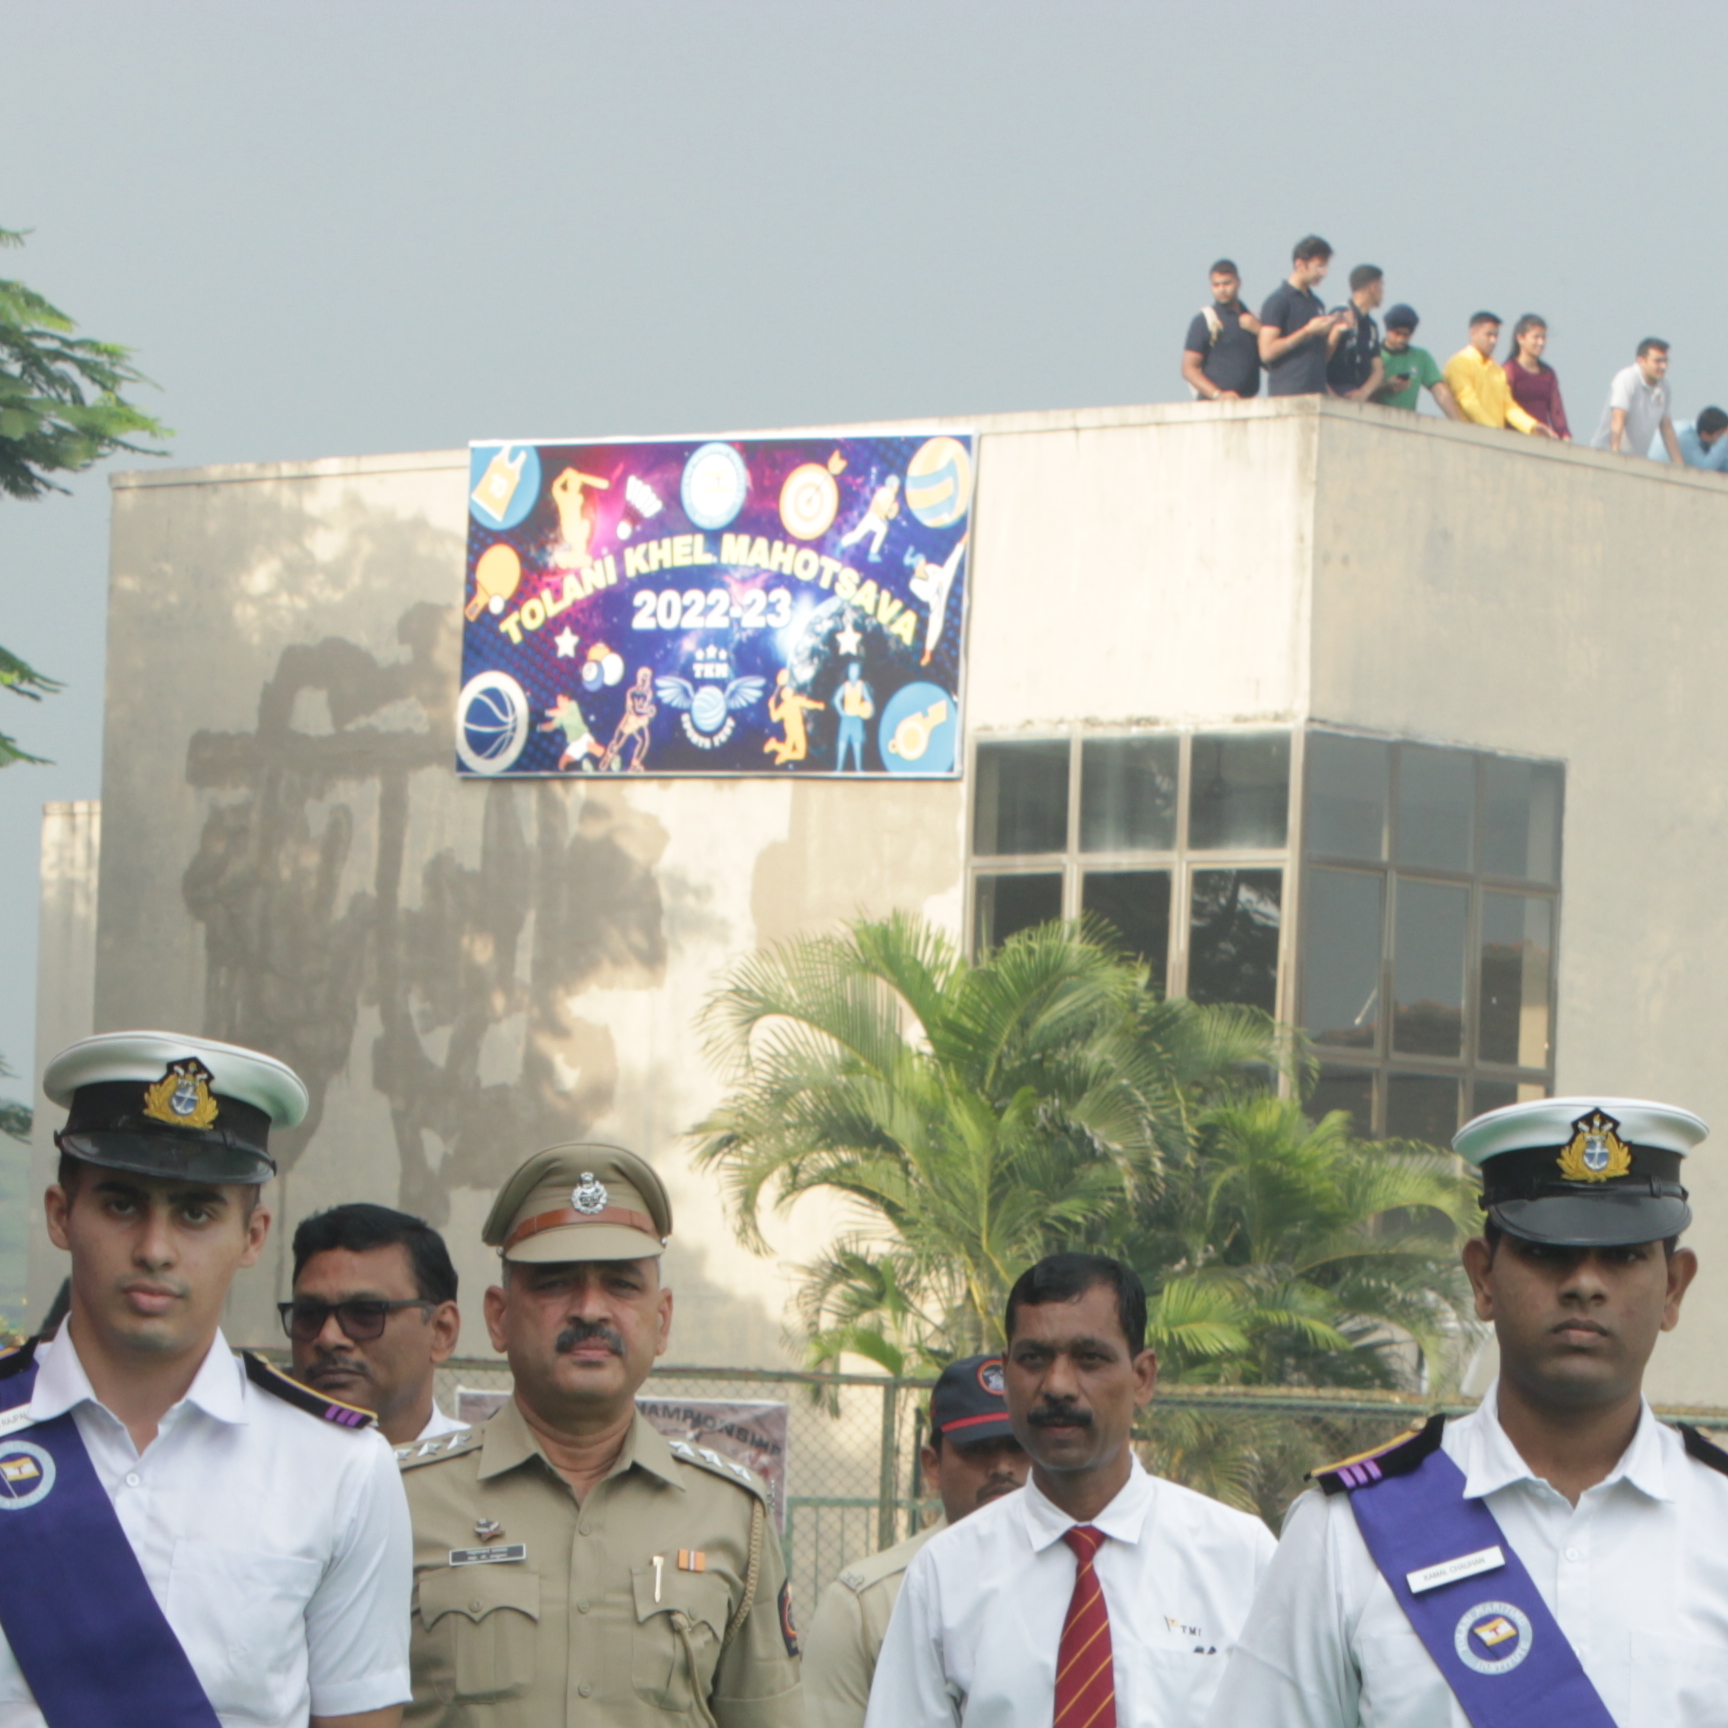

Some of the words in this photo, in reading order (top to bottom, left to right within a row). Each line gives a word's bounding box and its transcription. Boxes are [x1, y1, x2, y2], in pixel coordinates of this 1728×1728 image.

[498, 554, 618, 645] TOLANI
[624, 533, 714, 578] KHEL
[720, 531, 919, 647] MAHOTSAVA
[630, 587, 793, 630] 2022-23
[637, 1401, 783, 1457] HAMPIONSHIP
[1180, 1624, 1202, 1638] TMI
